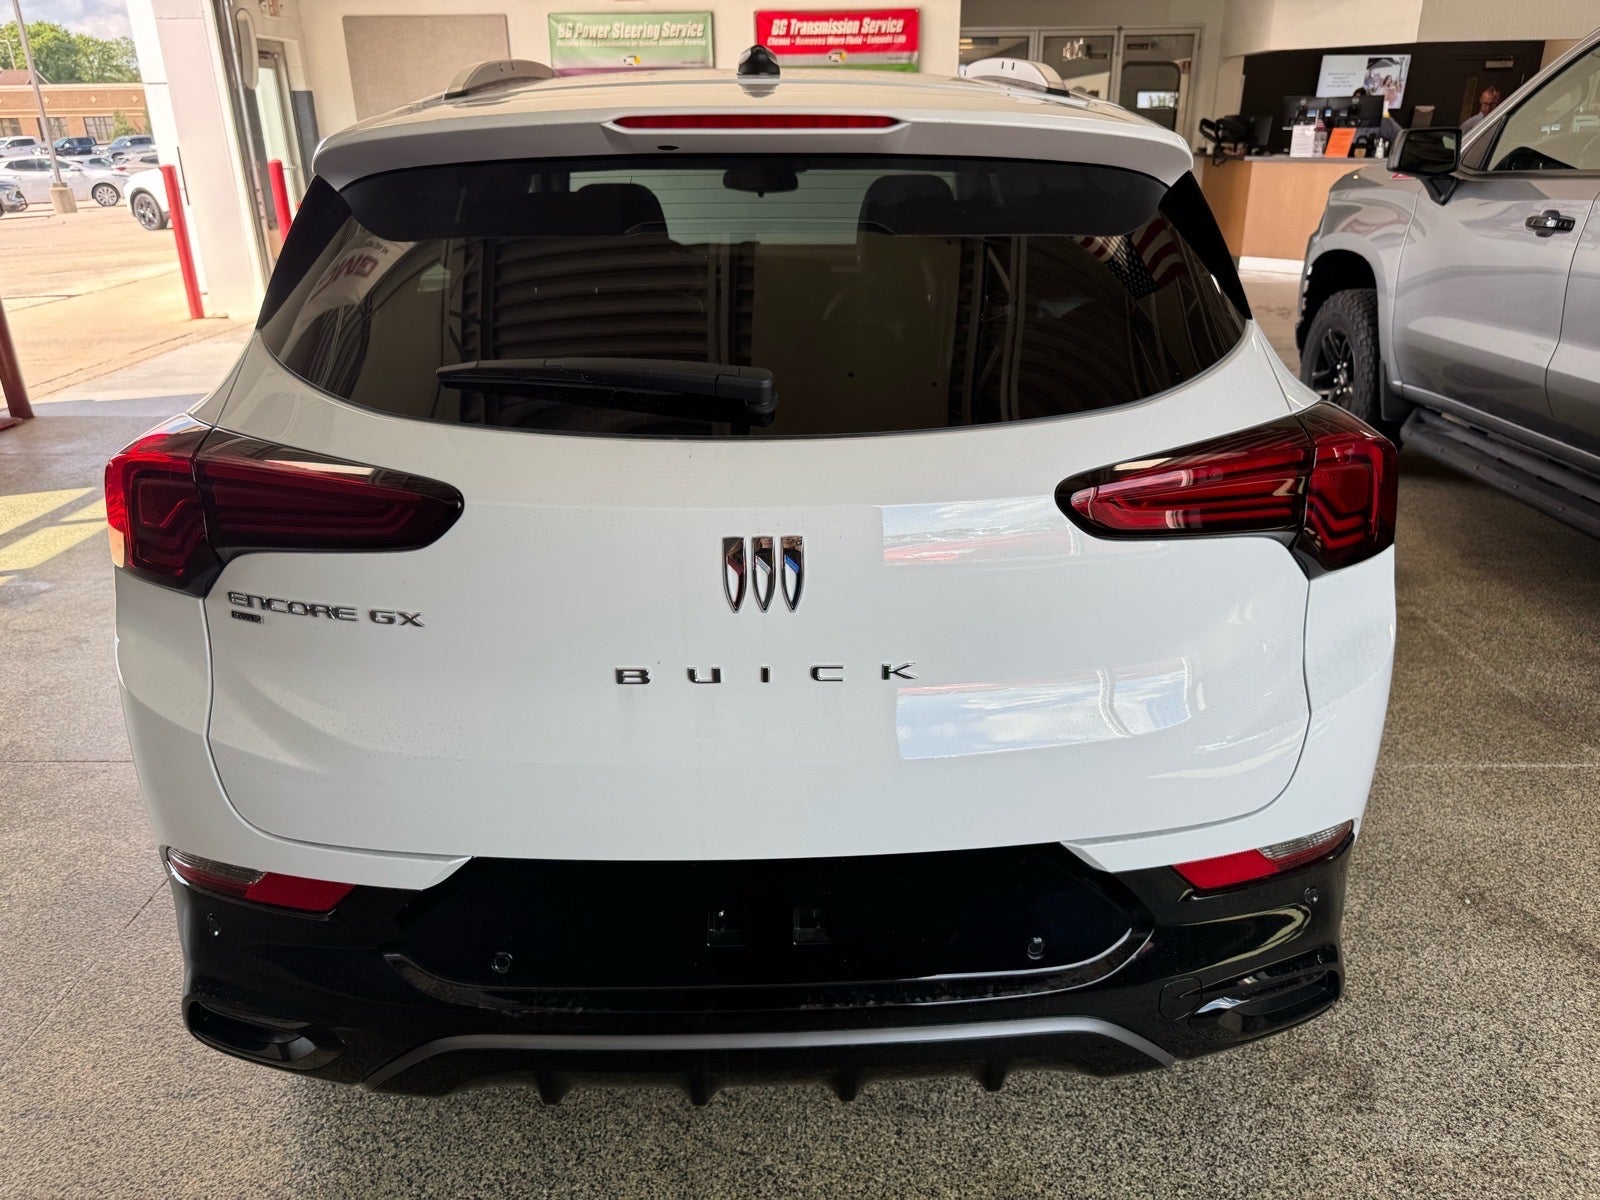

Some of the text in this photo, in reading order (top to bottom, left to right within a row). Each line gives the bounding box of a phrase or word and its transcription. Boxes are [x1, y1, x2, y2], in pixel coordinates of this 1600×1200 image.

[557, 21, 705, 41] BG Power Steering Service
[772, 17, 904, 35] BG Transmission Service
[227, 590, 425, 627] ENCORE GX
[616, 662, 919, 685] BUICK
